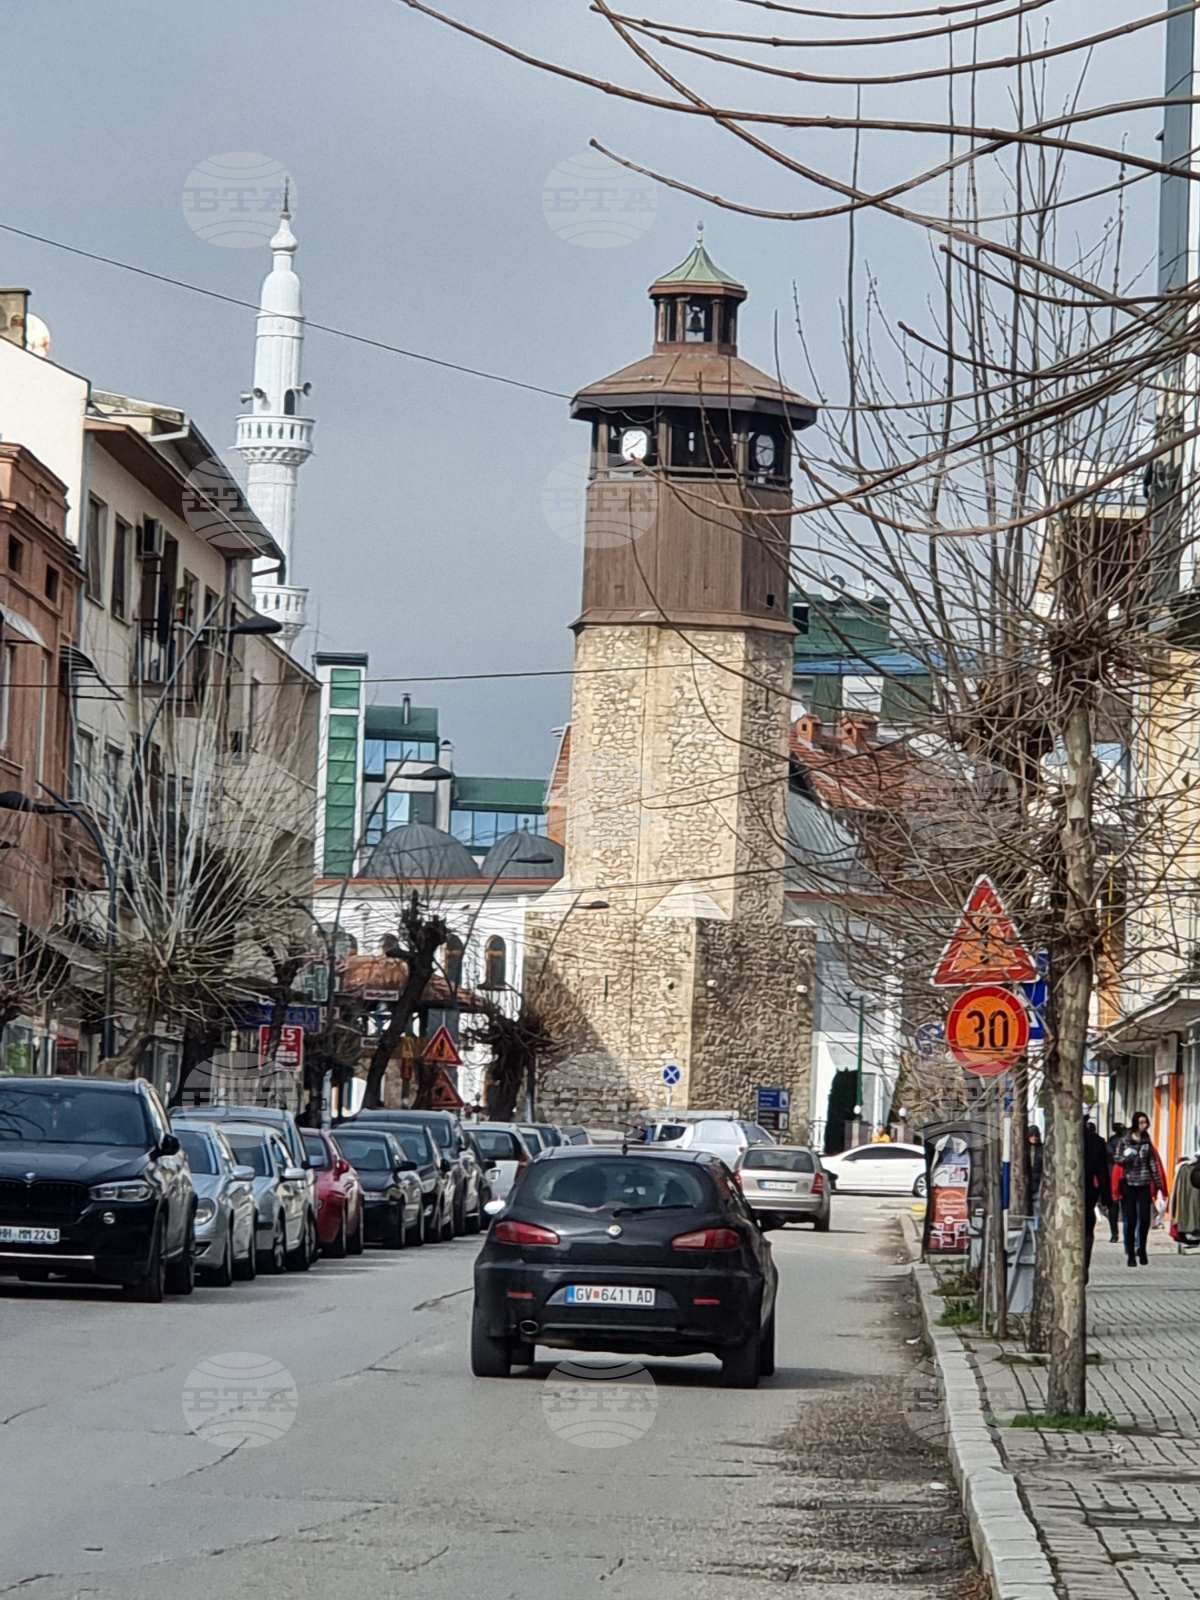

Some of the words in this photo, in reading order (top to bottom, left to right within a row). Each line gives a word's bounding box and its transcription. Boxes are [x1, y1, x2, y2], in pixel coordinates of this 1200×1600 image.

[966, 1009, 1009, 1051] 30
[575, 1287, 593, 1301] GV
[600, 1288, 633, 1302] 6411
[636, 1289, 653, 1303] AD
